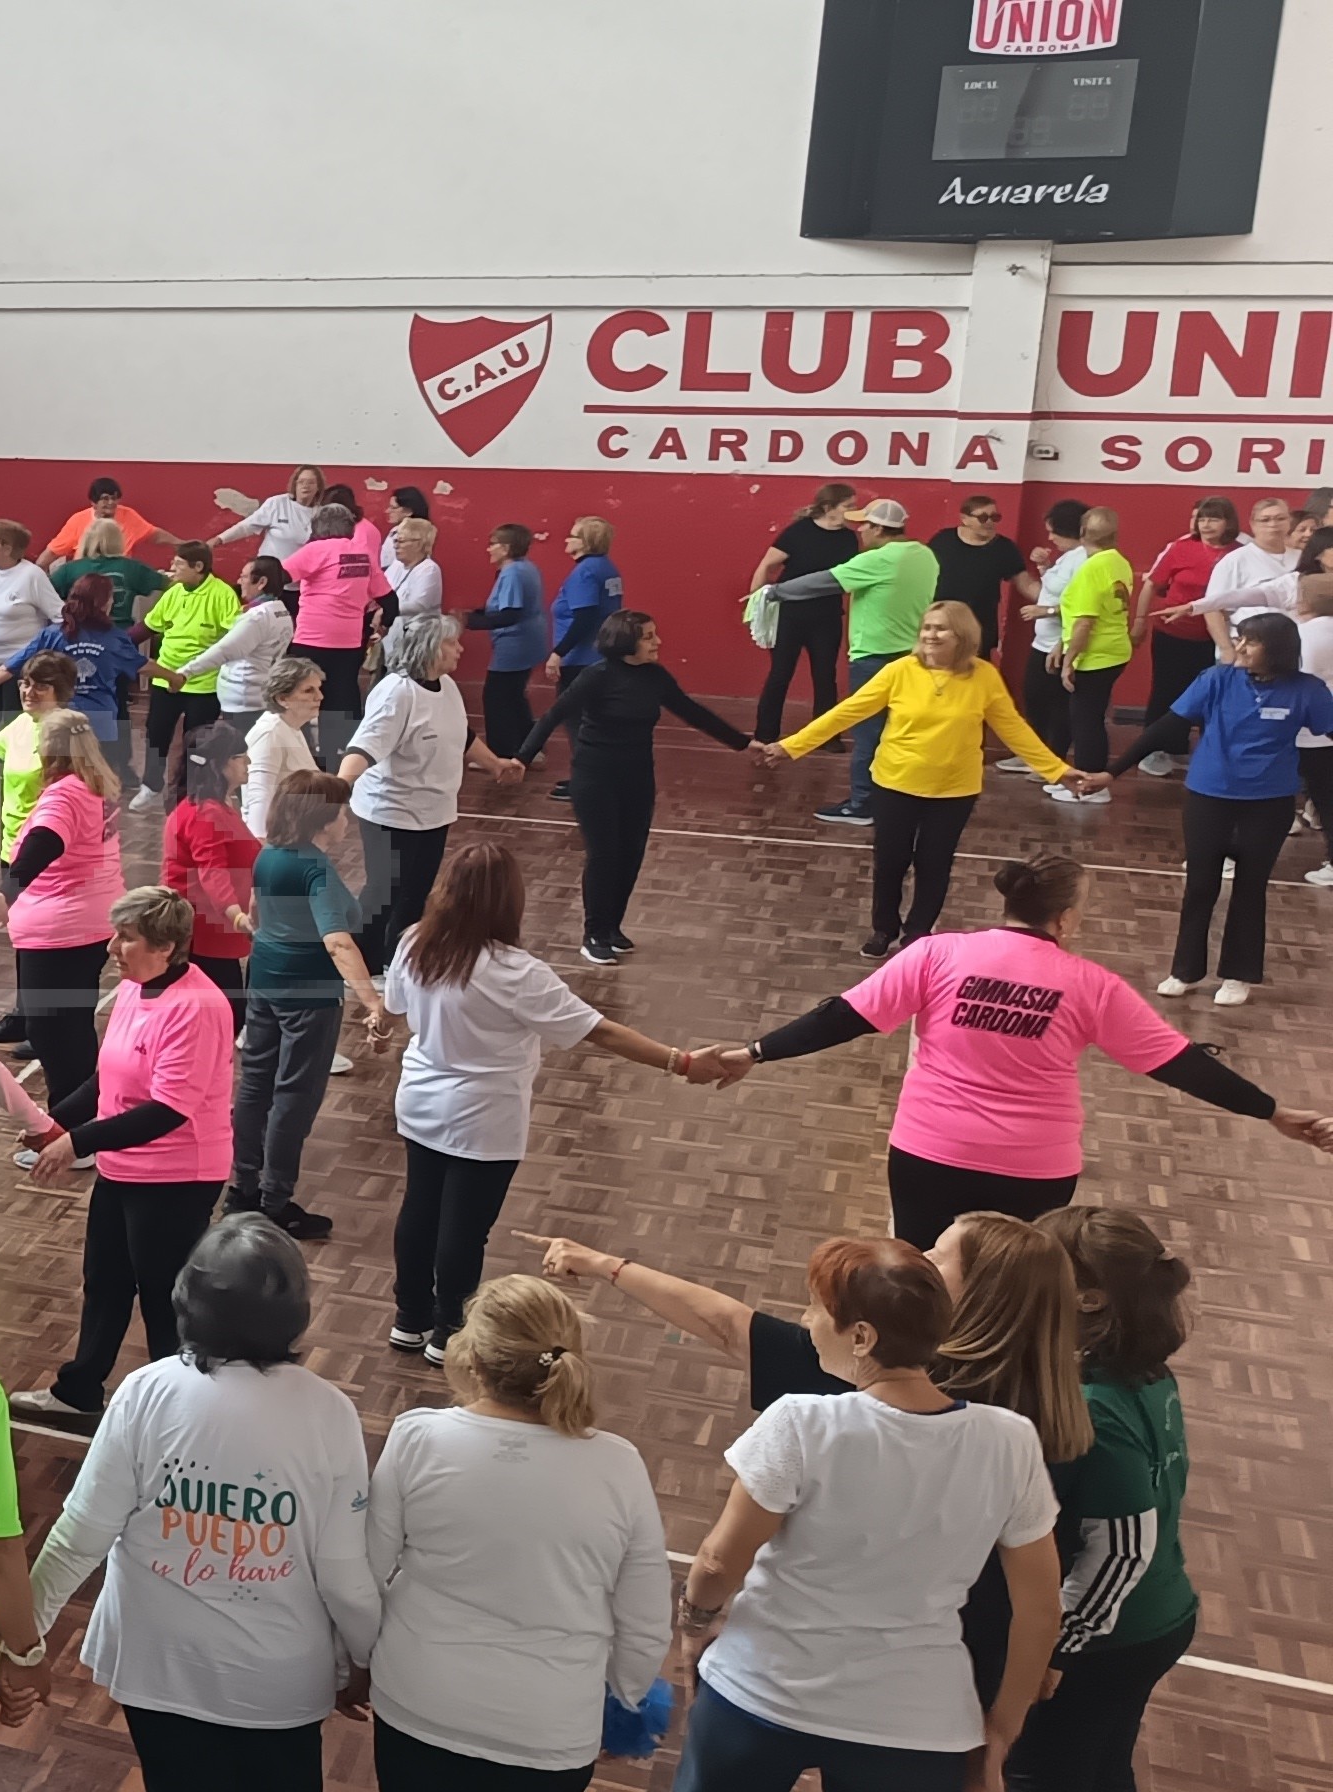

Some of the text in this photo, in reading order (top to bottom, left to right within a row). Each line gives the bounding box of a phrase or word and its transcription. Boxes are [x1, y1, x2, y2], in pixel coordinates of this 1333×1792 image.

[975, 0, 1118, 50] UNION
[1002, 42, 1081, 54] CARDONA
[964, 80, 1000, 90] LOCAL
[937, 174, 1111, 205] Acuarela
[586, 309, 1333, 399] CLUB UNI
[596, 425, 1326, 475] CARDONA SORI
[955, 974, 1065, 1014] GIMNASIA
[950, 1001, 1053, 1039] CARDONA
[154, 1474, 297, 1527] QUIERO
[161, 1506, 286, 1557] PUEDO
[183, 1547, 218, 1587] lo
